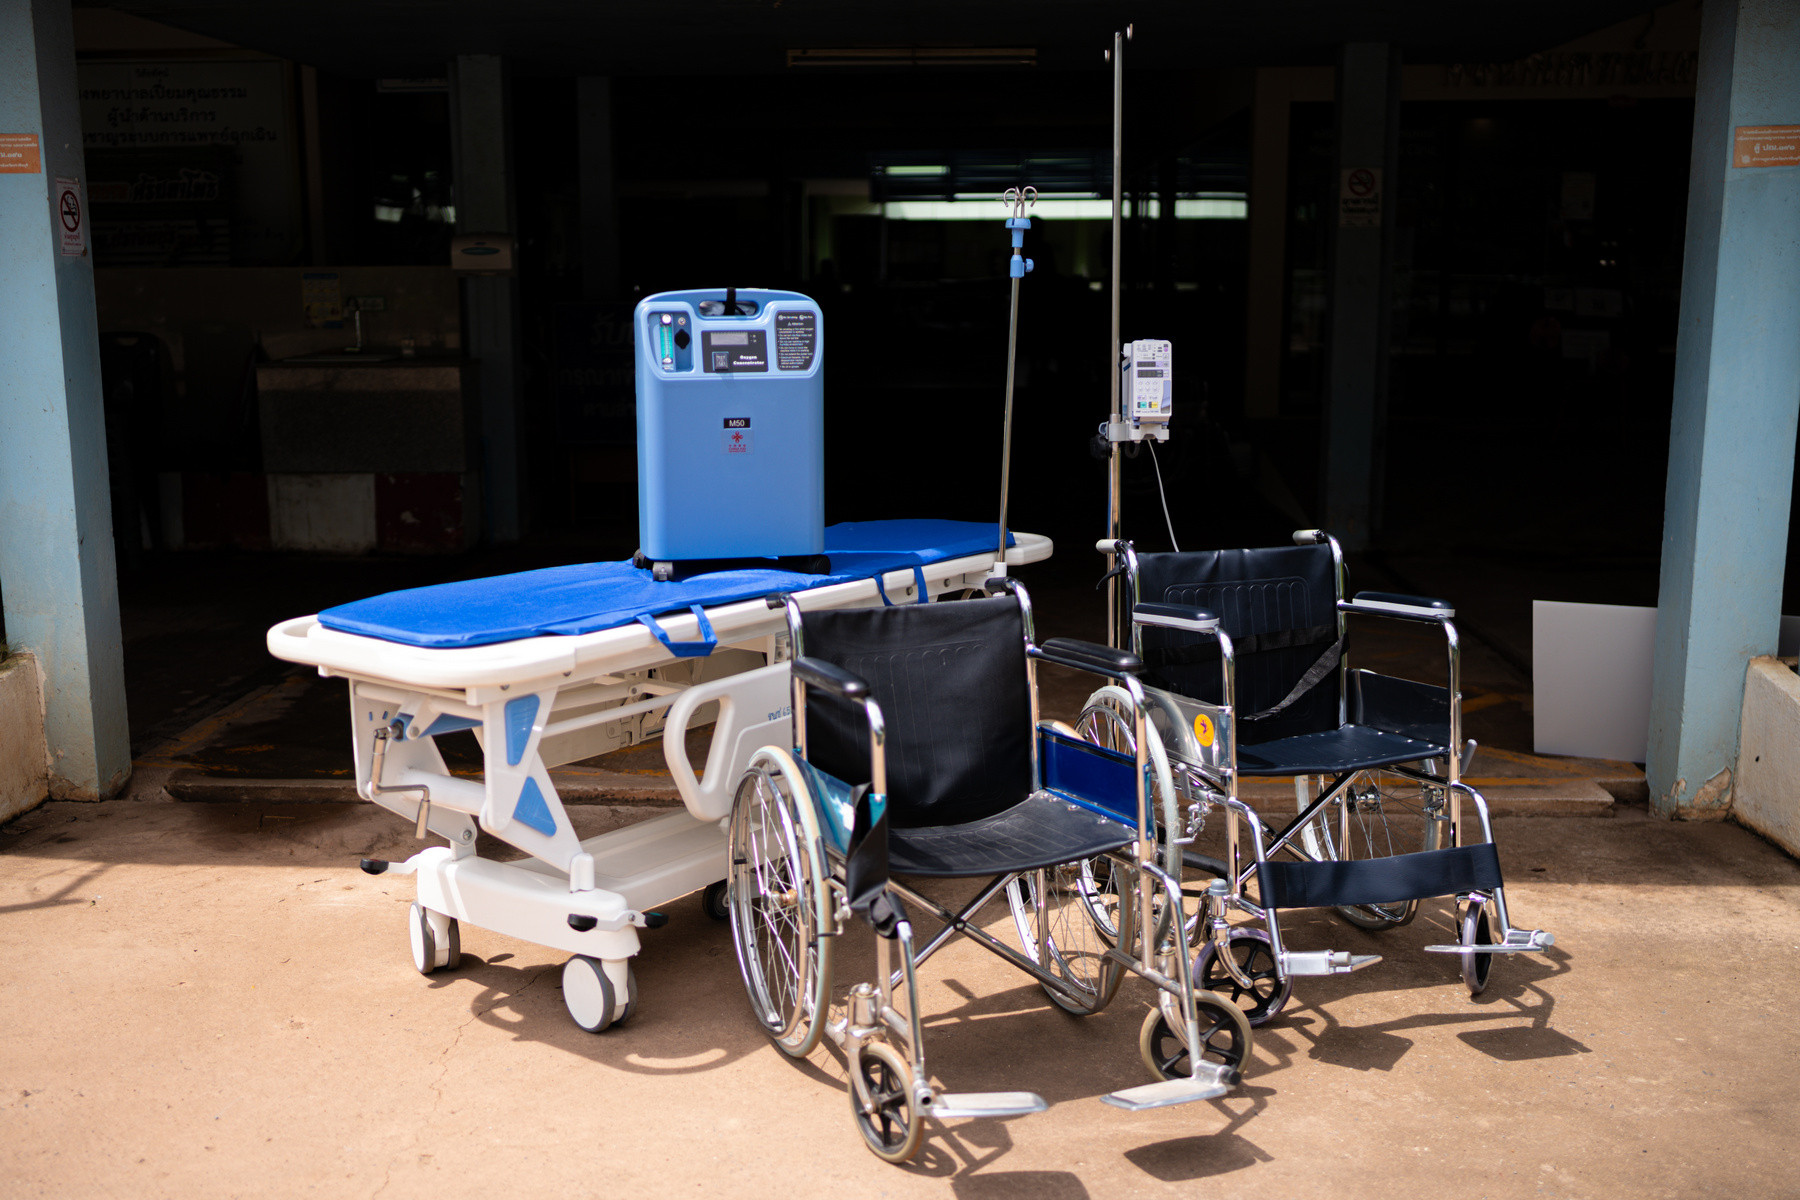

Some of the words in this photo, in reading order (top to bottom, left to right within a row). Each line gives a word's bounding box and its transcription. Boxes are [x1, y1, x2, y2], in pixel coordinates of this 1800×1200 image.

[107, 104, 216, 128] ผู้นำด้านบริการ
[729, 419, 745, 427] M50
